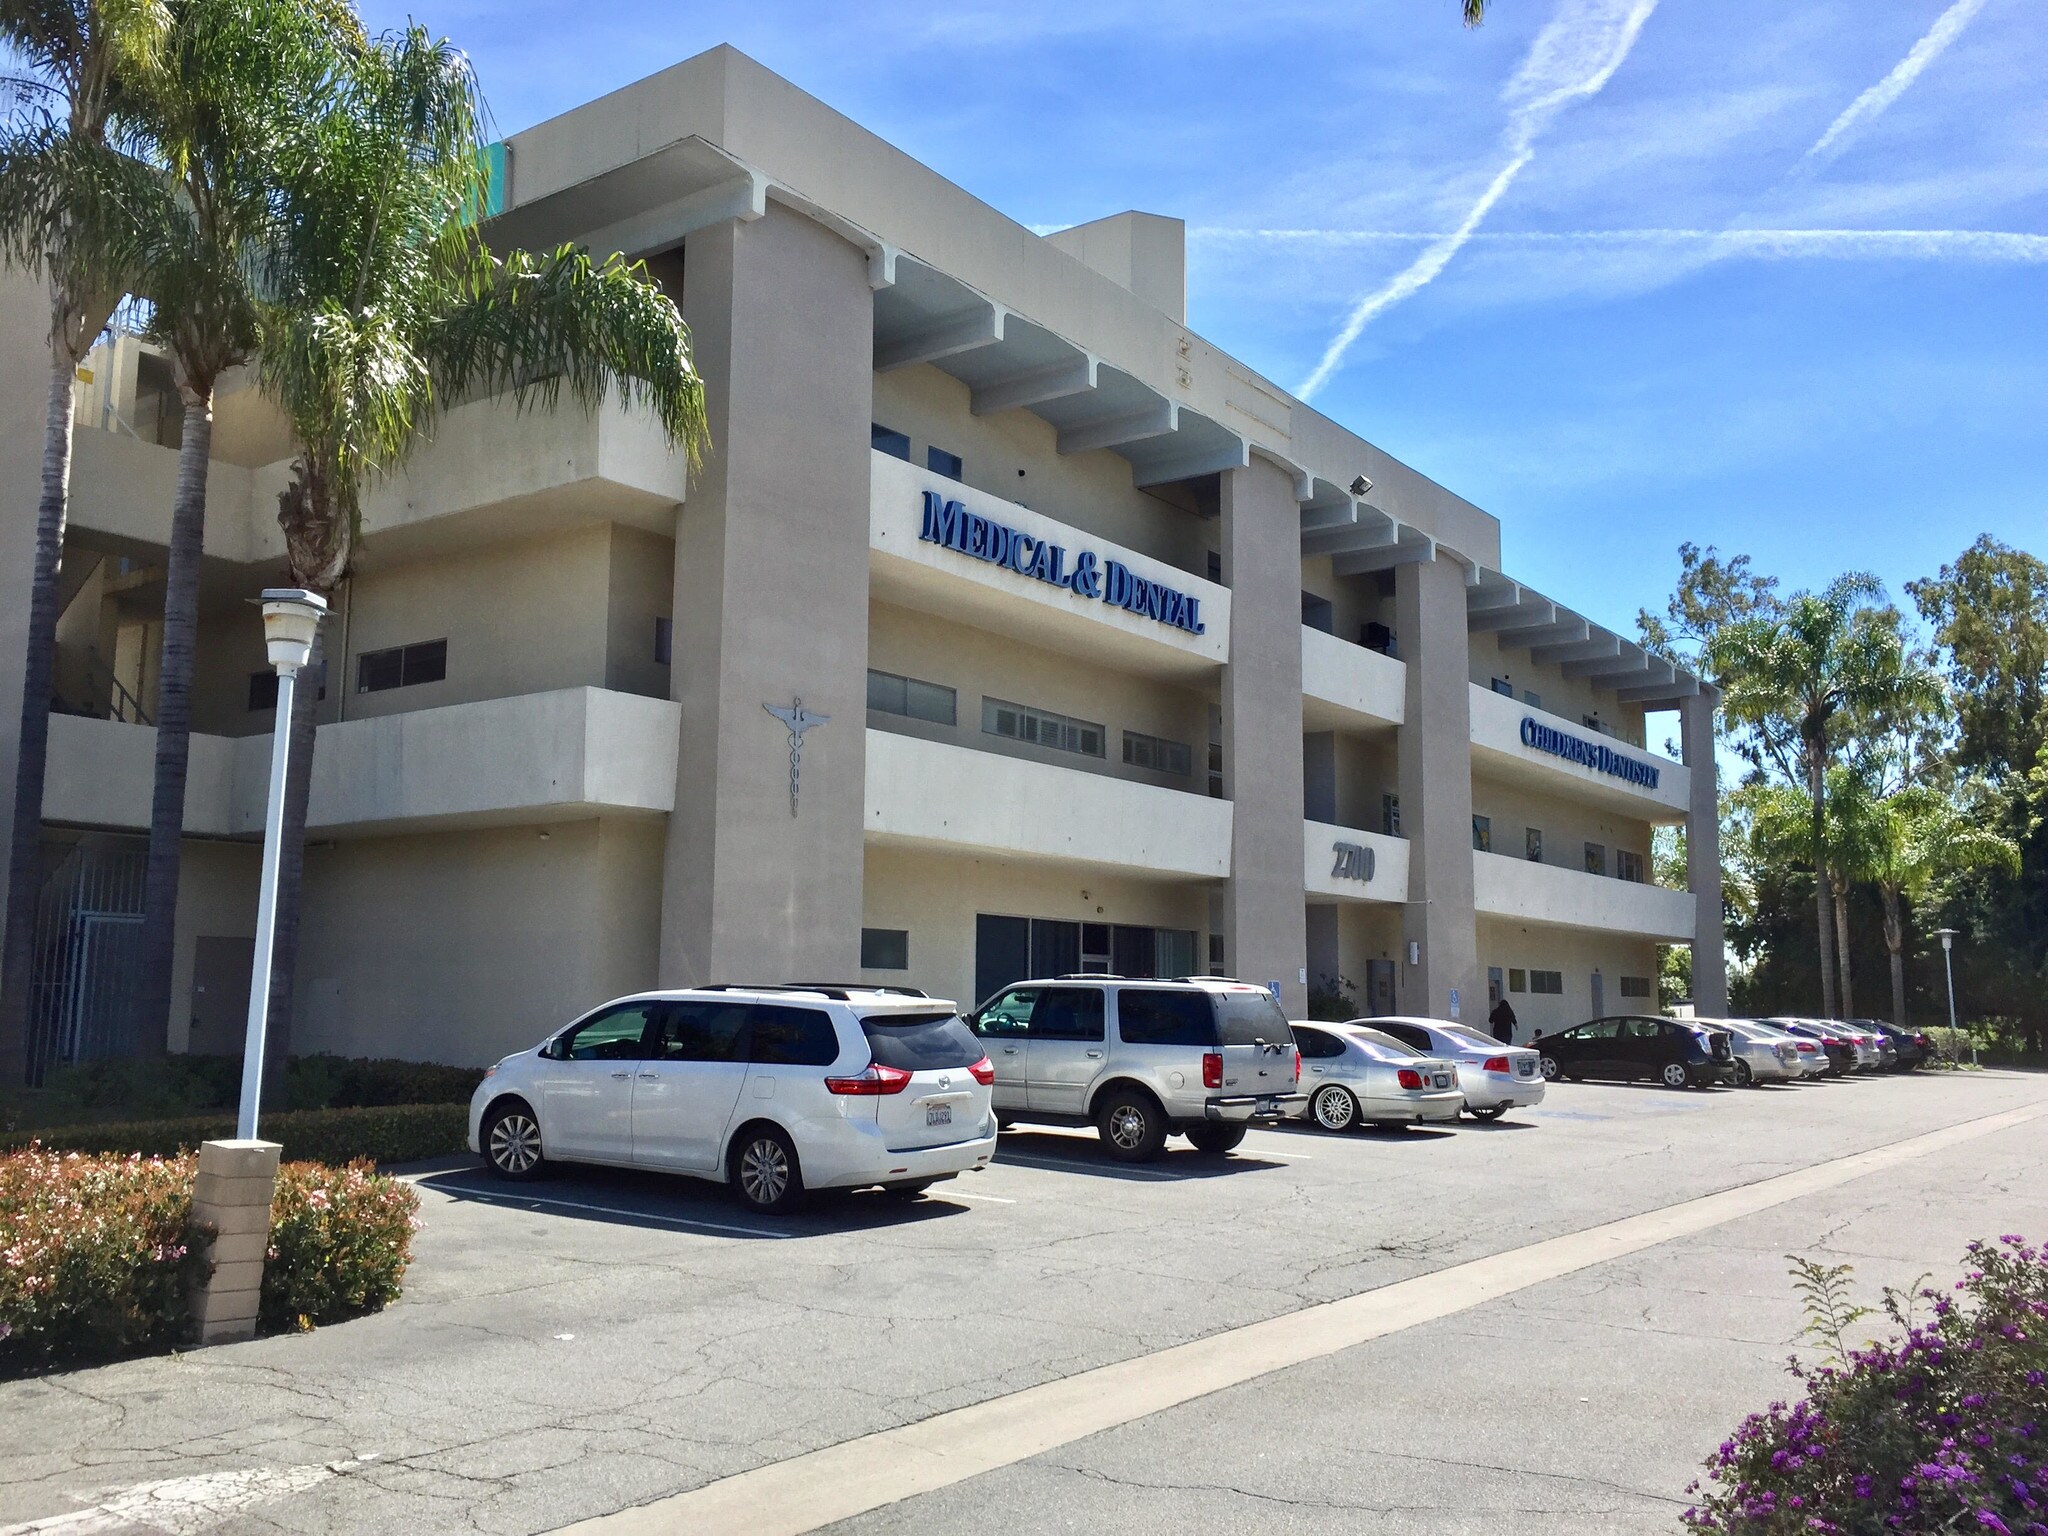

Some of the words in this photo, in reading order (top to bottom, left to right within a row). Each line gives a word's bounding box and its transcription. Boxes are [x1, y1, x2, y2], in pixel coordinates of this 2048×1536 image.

[919, 491, 1070, 588] MEDICAL
[1071, 552, 1102, 599] &
[1103, 561, 1205, 635] DENTAL
[1598, 746, 1660, 788] DENTISTRY
